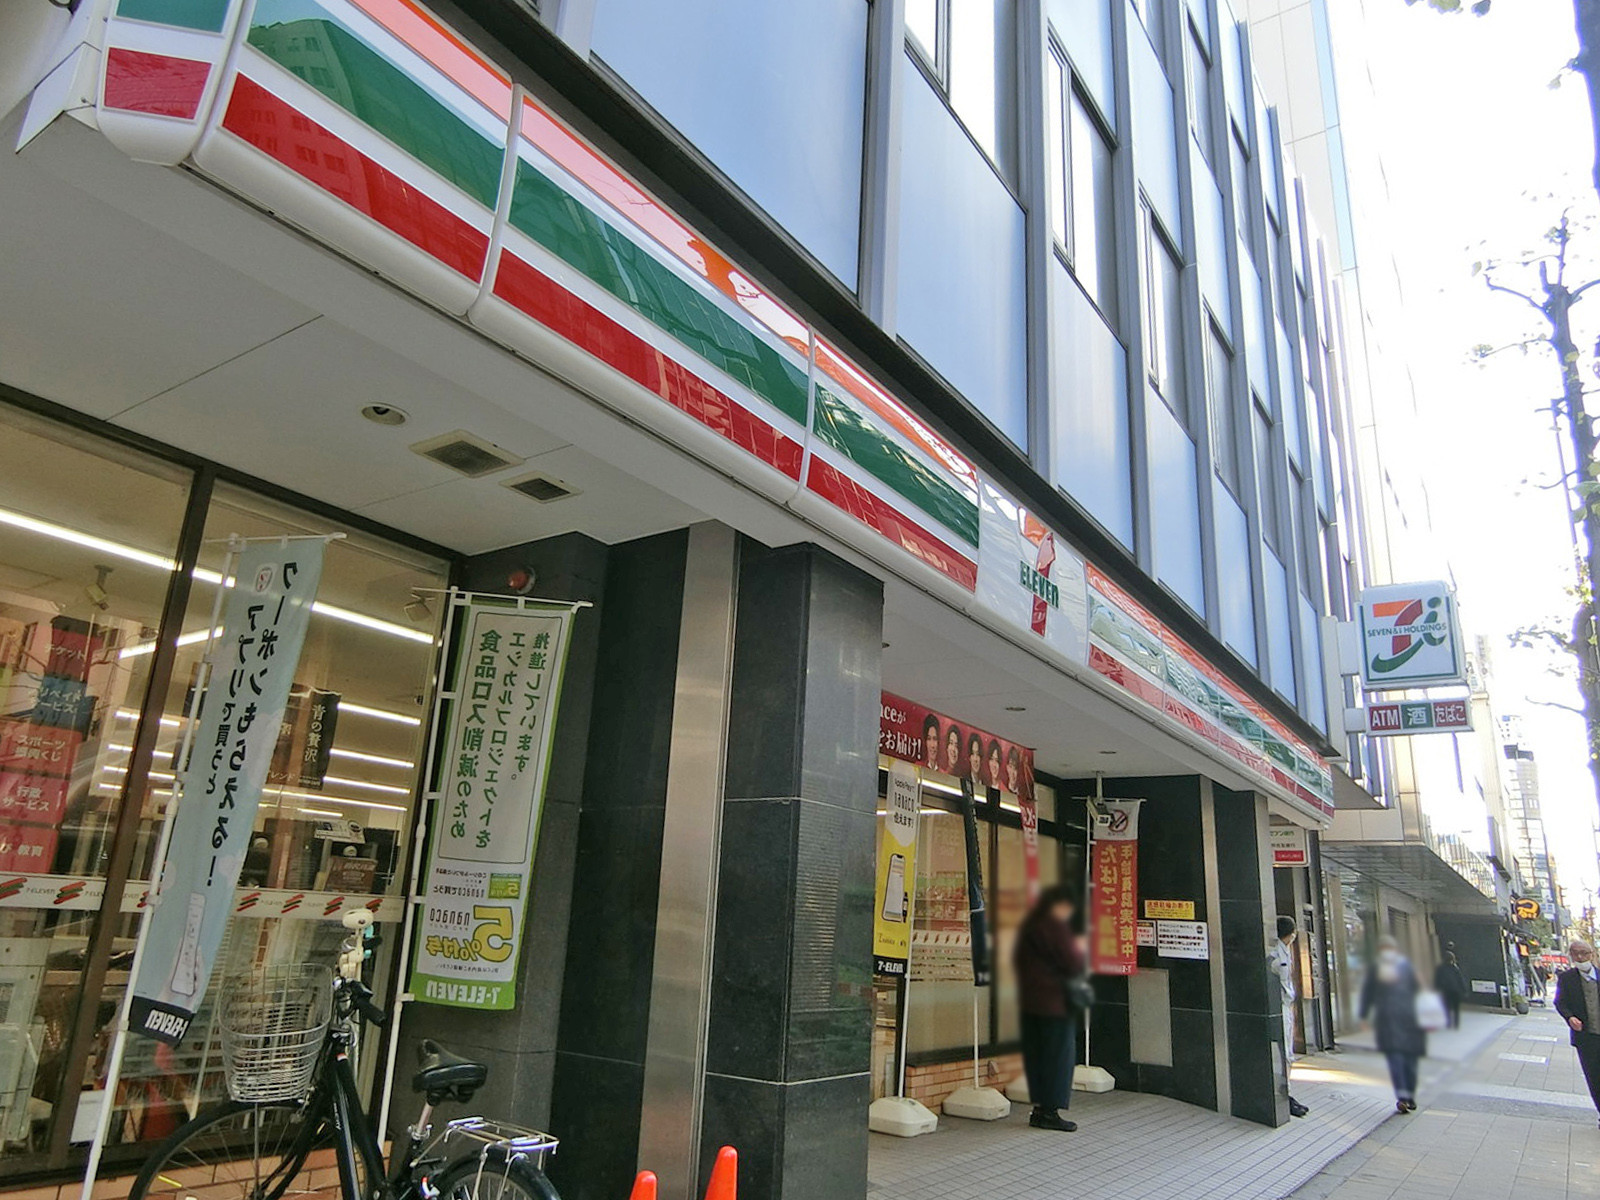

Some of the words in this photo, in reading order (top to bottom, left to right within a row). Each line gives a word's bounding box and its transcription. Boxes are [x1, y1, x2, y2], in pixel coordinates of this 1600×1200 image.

[1404, 622, 1447, 634] HOLDINGS
[1371, 709, 1399, 727] ATM
[1407, 706, 1428, 726] 酒
[1435, 704, 1467, 724] たばこ
[17, 734, 65, 750] スポーツ
[2, 796, 50, 811] サービス
